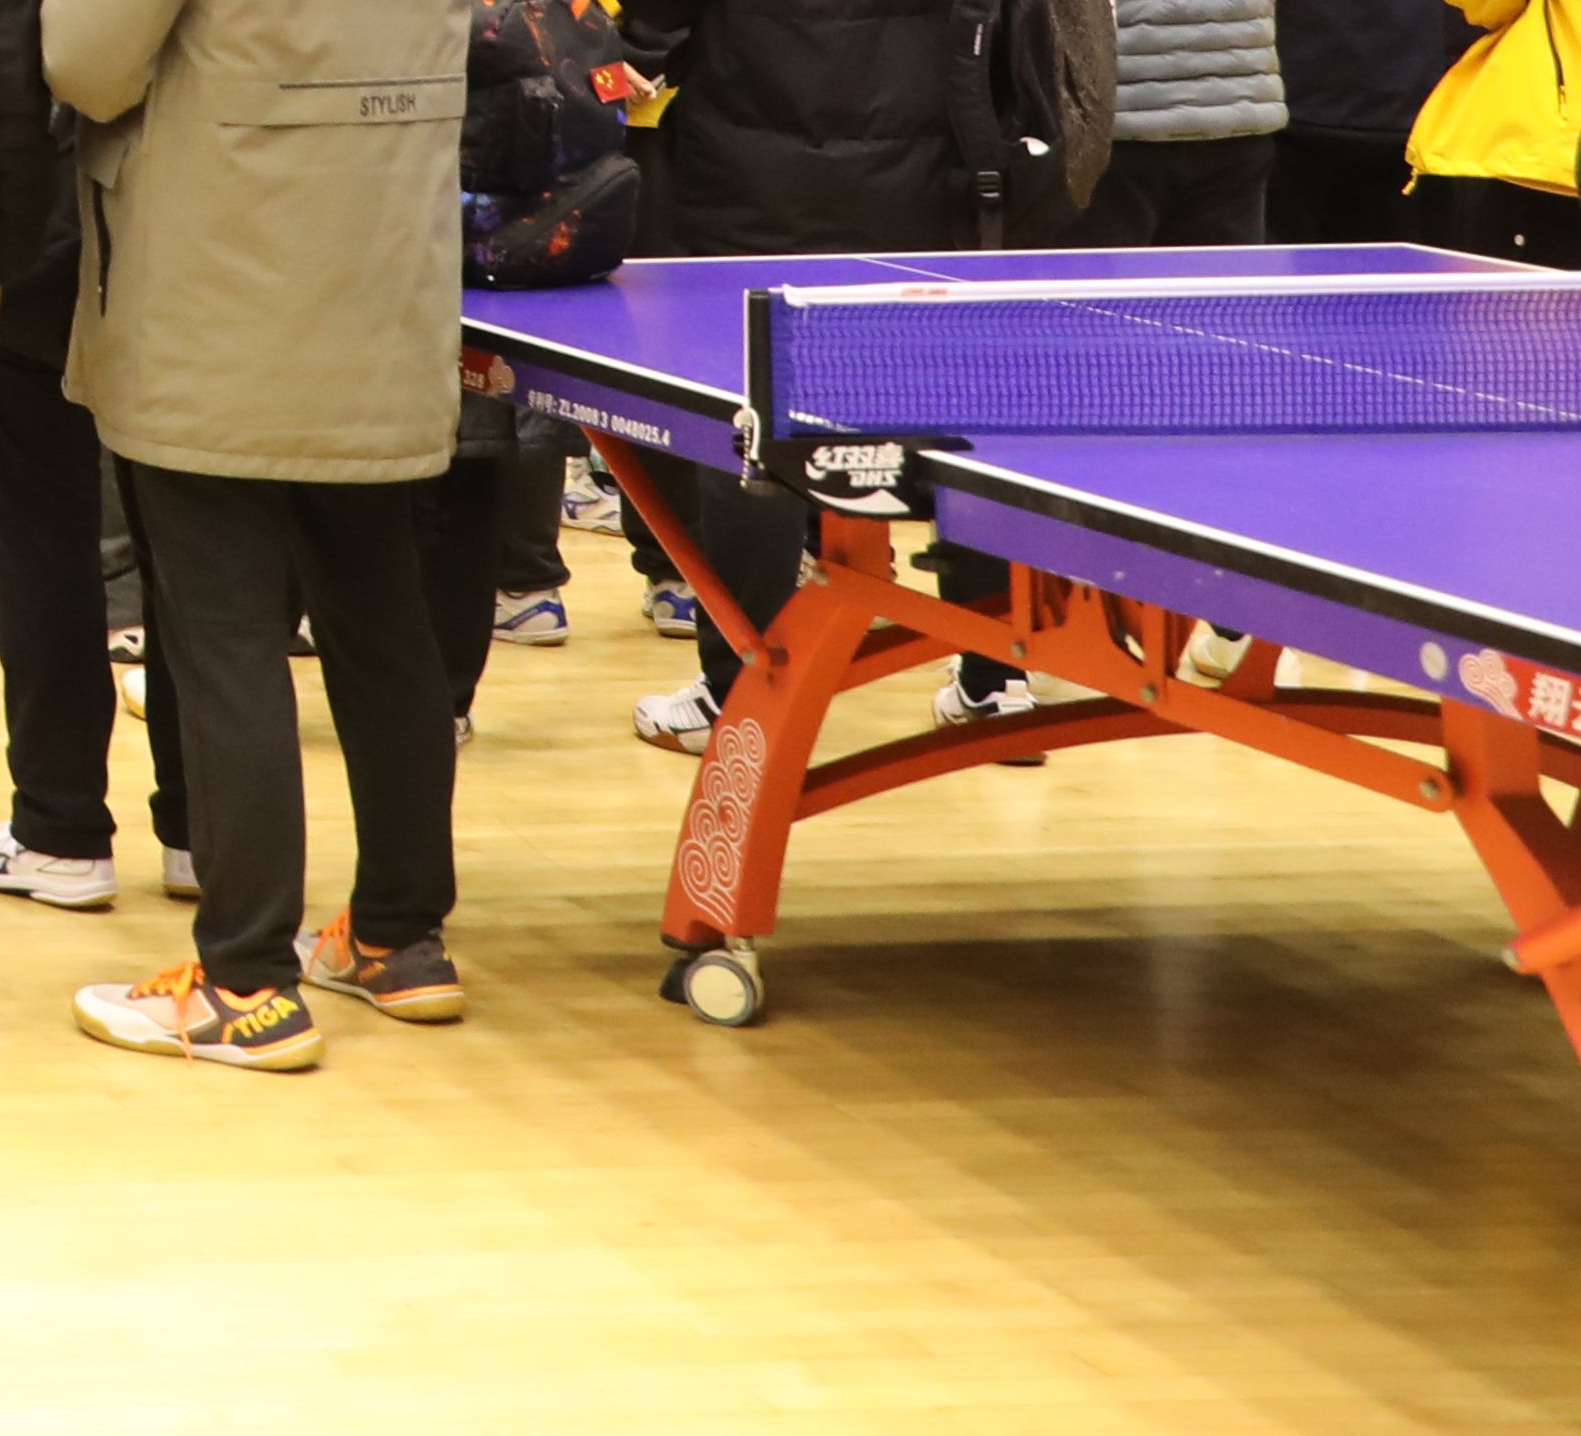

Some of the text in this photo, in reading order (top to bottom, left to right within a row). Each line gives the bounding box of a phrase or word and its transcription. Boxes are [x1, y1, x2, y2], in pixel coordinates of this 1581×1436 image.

[359, 93, 416, 116] STYLISH
[848, 470, 902, 487] DHS
[1528, 671, 1581, 733] 翔
